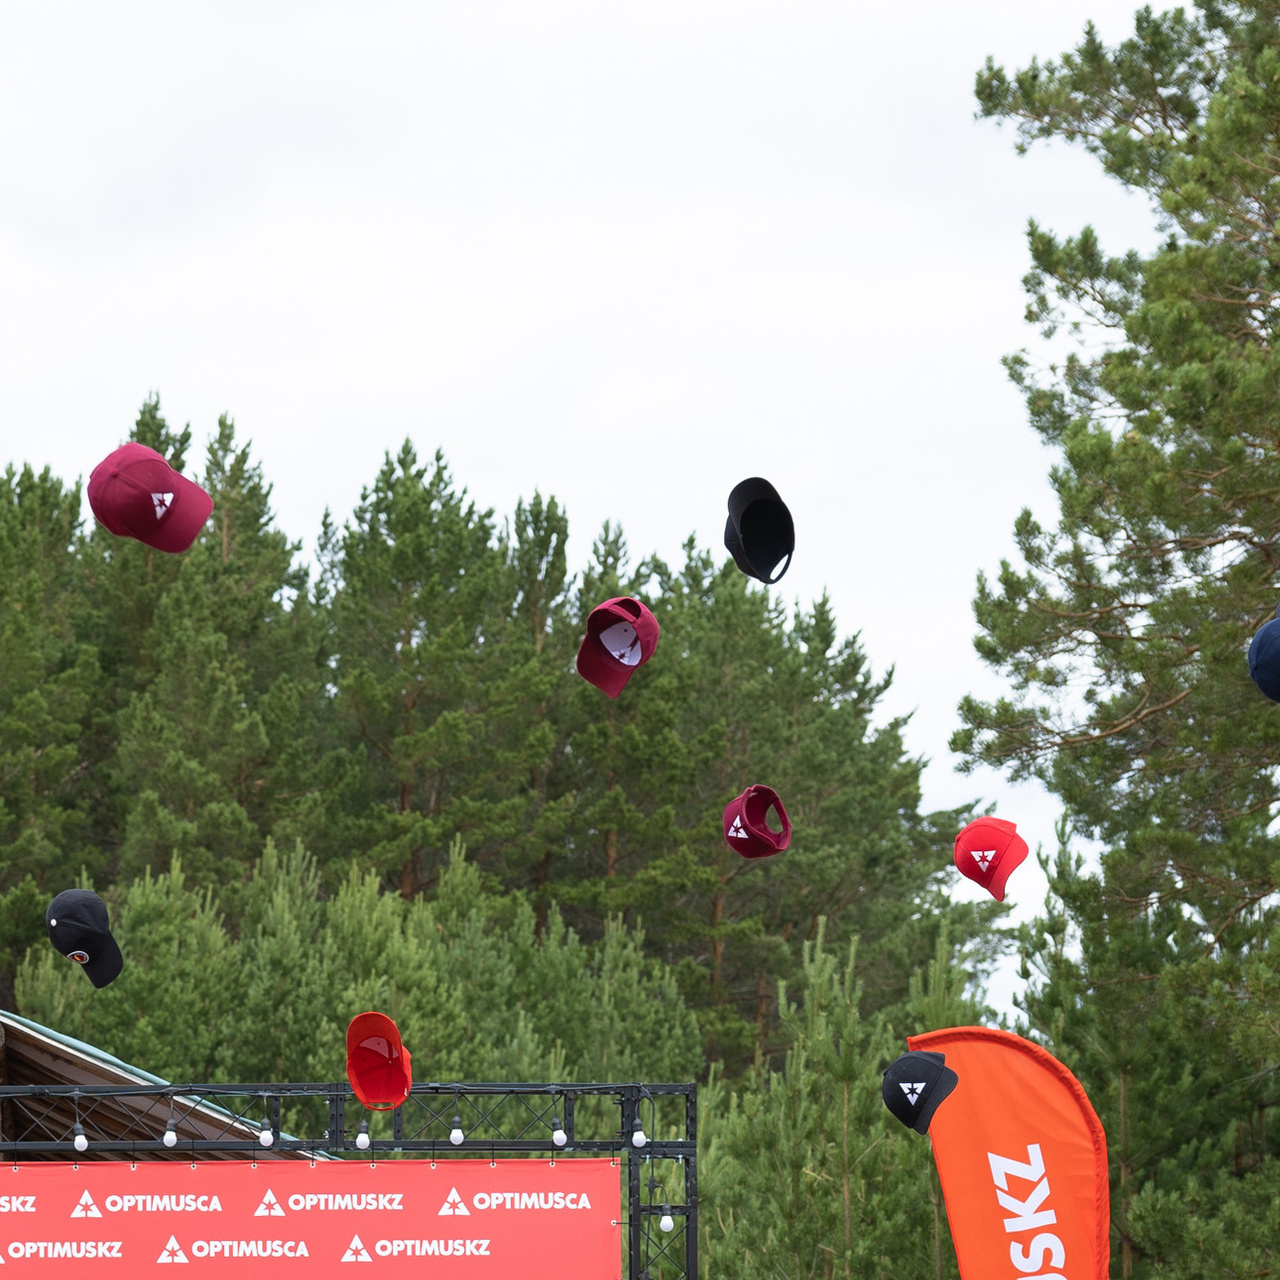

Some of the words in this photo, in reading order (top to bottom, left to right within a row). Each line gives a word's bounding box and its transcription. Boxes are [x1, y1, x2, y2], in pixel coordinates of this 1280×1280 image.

[104, 1194, 223, 1213] OPTIMUSCA
[287, 1193, 404, 1211] OPTIMUSKZ
[472, 1191, 592, 1210] OPTIMUSCA
[7, 1241, 123, 1259] OPTIMUSKZ
[191, 1239, 310, 1258] OPTIMUSCA
[374, 1239, 491, 1257] OPTIMUSKZ
